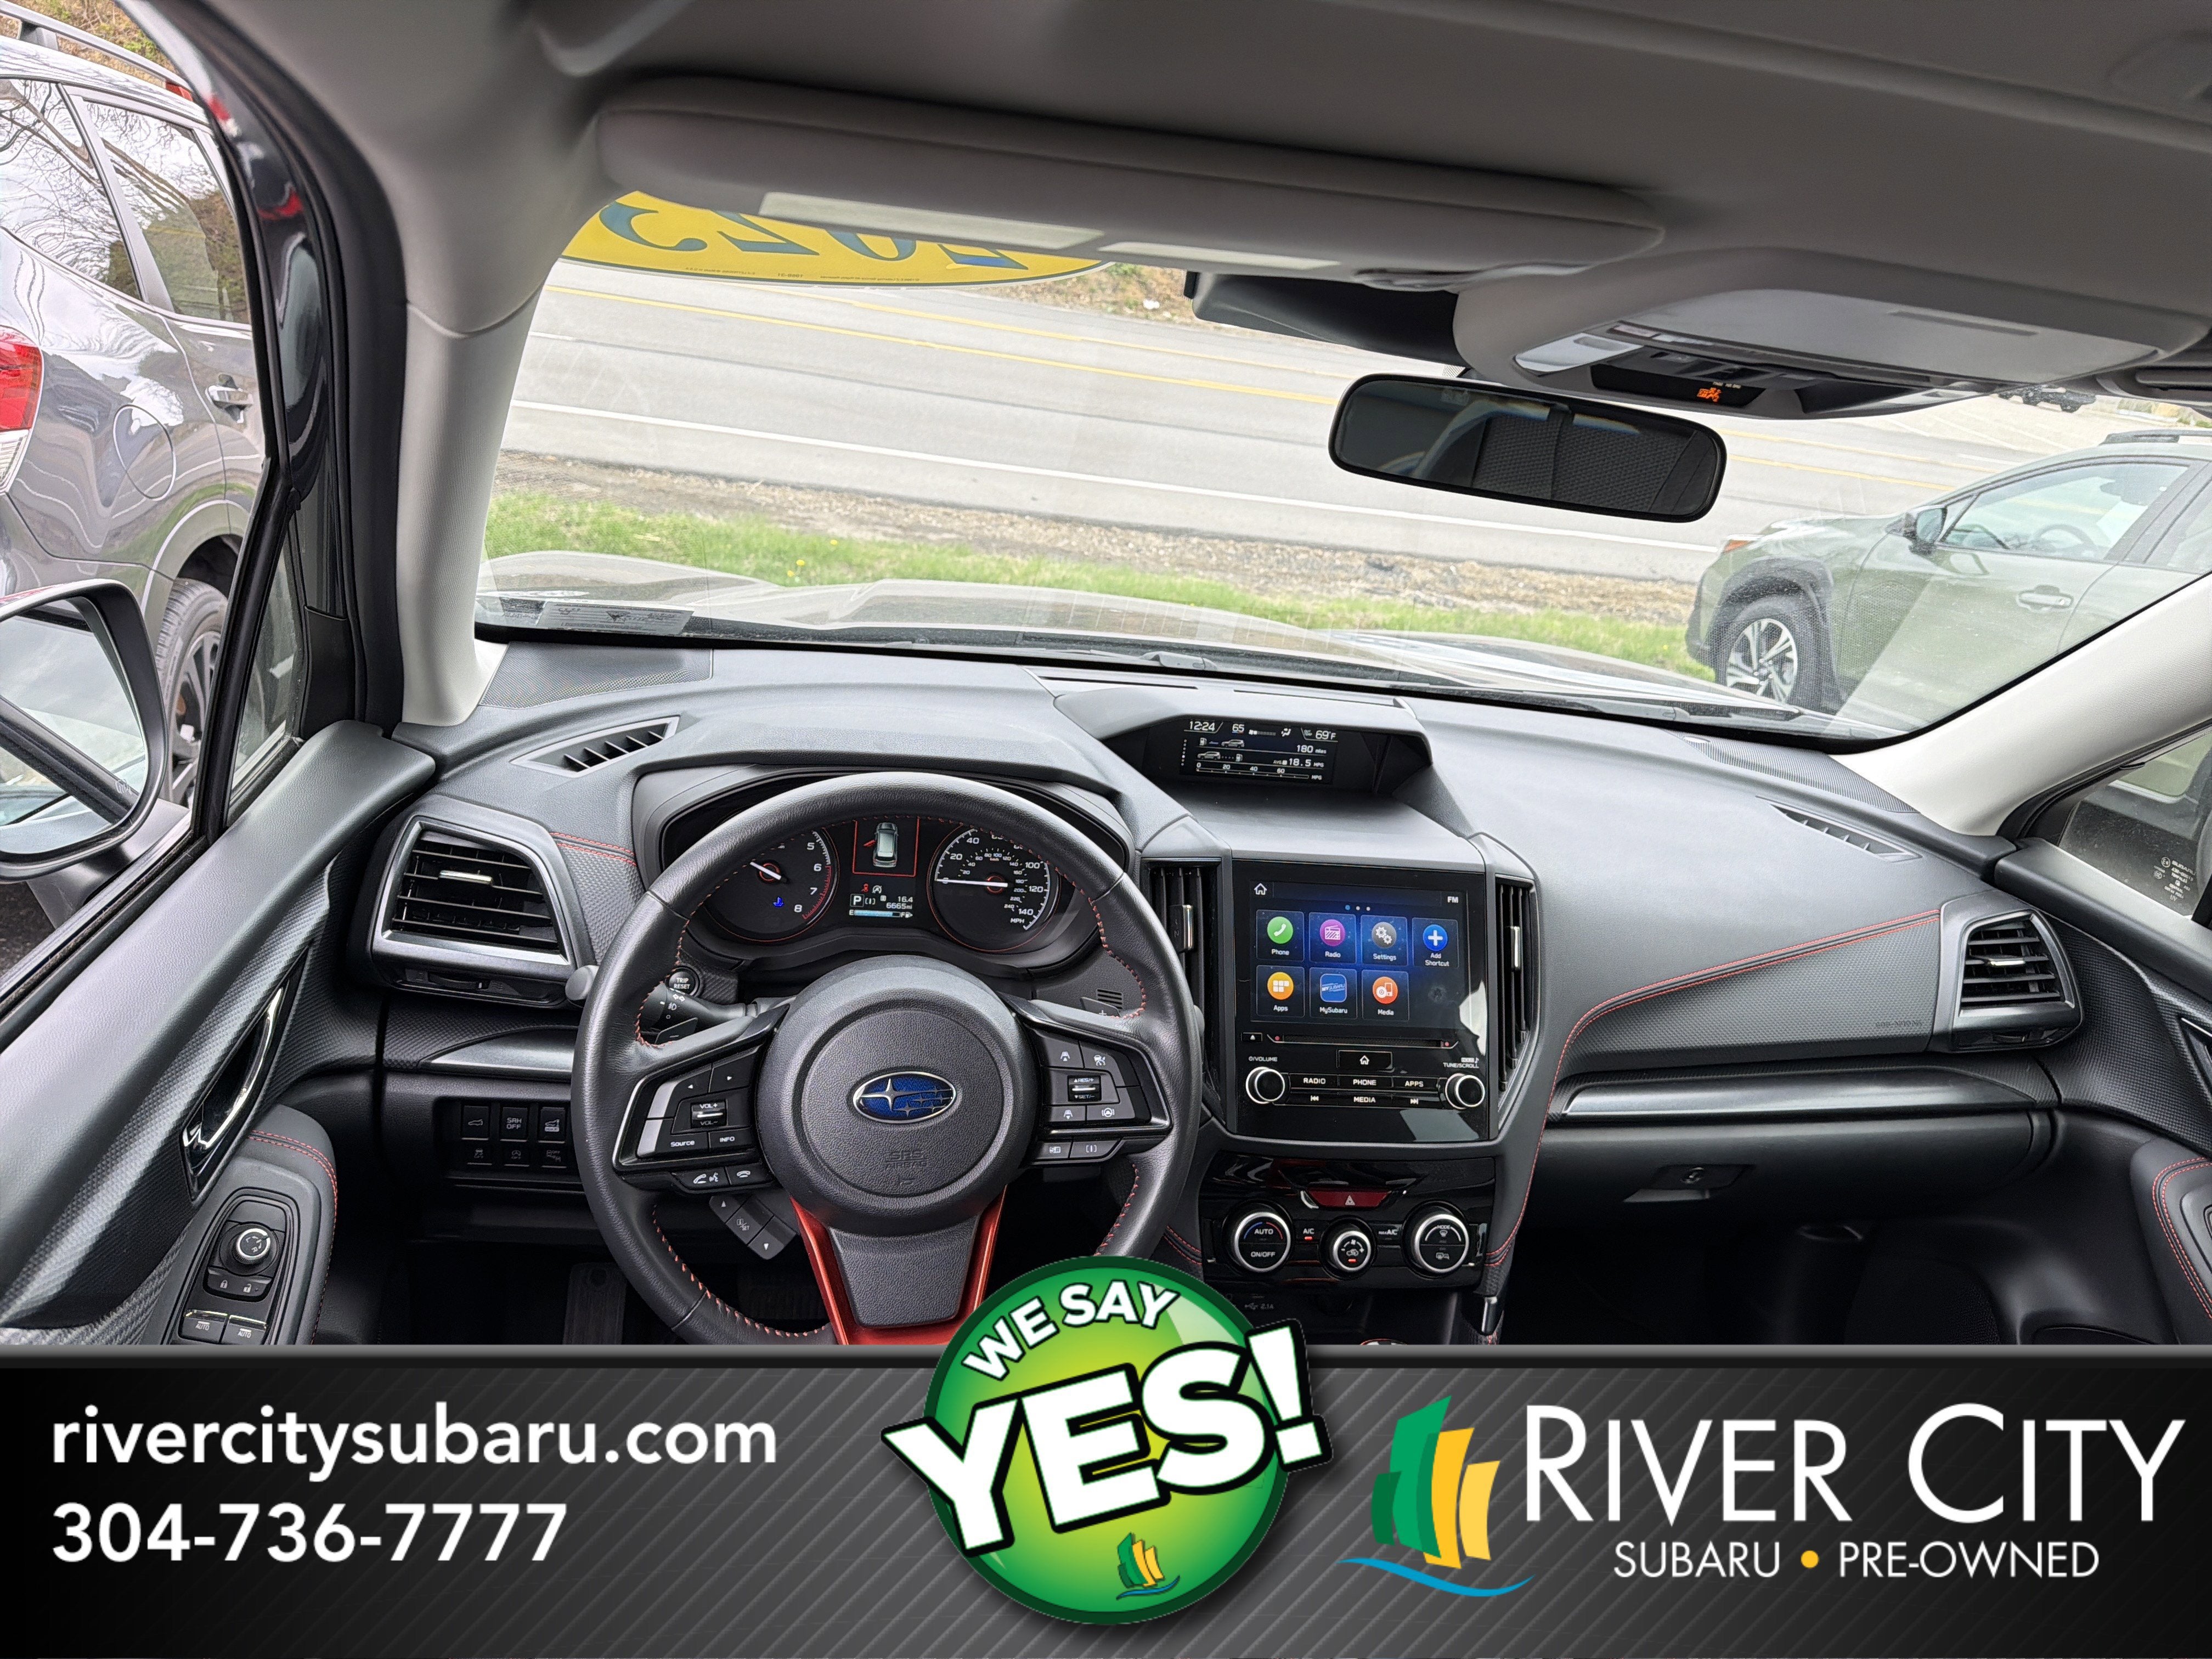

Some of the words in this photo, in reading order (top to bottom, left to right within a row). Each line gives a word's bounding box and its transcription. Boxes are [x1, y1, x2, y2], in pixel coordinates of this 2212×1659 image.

[1190, 721, 1215, 731] 12:24
[1232, 724, 1245, 732] 65
[1297, 744, 1313, 753] 180
[1289, 758, 1311, 767] 18.5
[807, 842, 815, 850] 5
[814, 864, 822, 872] 6
[853, 895, 861, 905] P
[794, 904, 803, 912] 8
[1373, 953, 1397, 962] Settings
[1319, 1006, 1348, 1015] MySubaru
